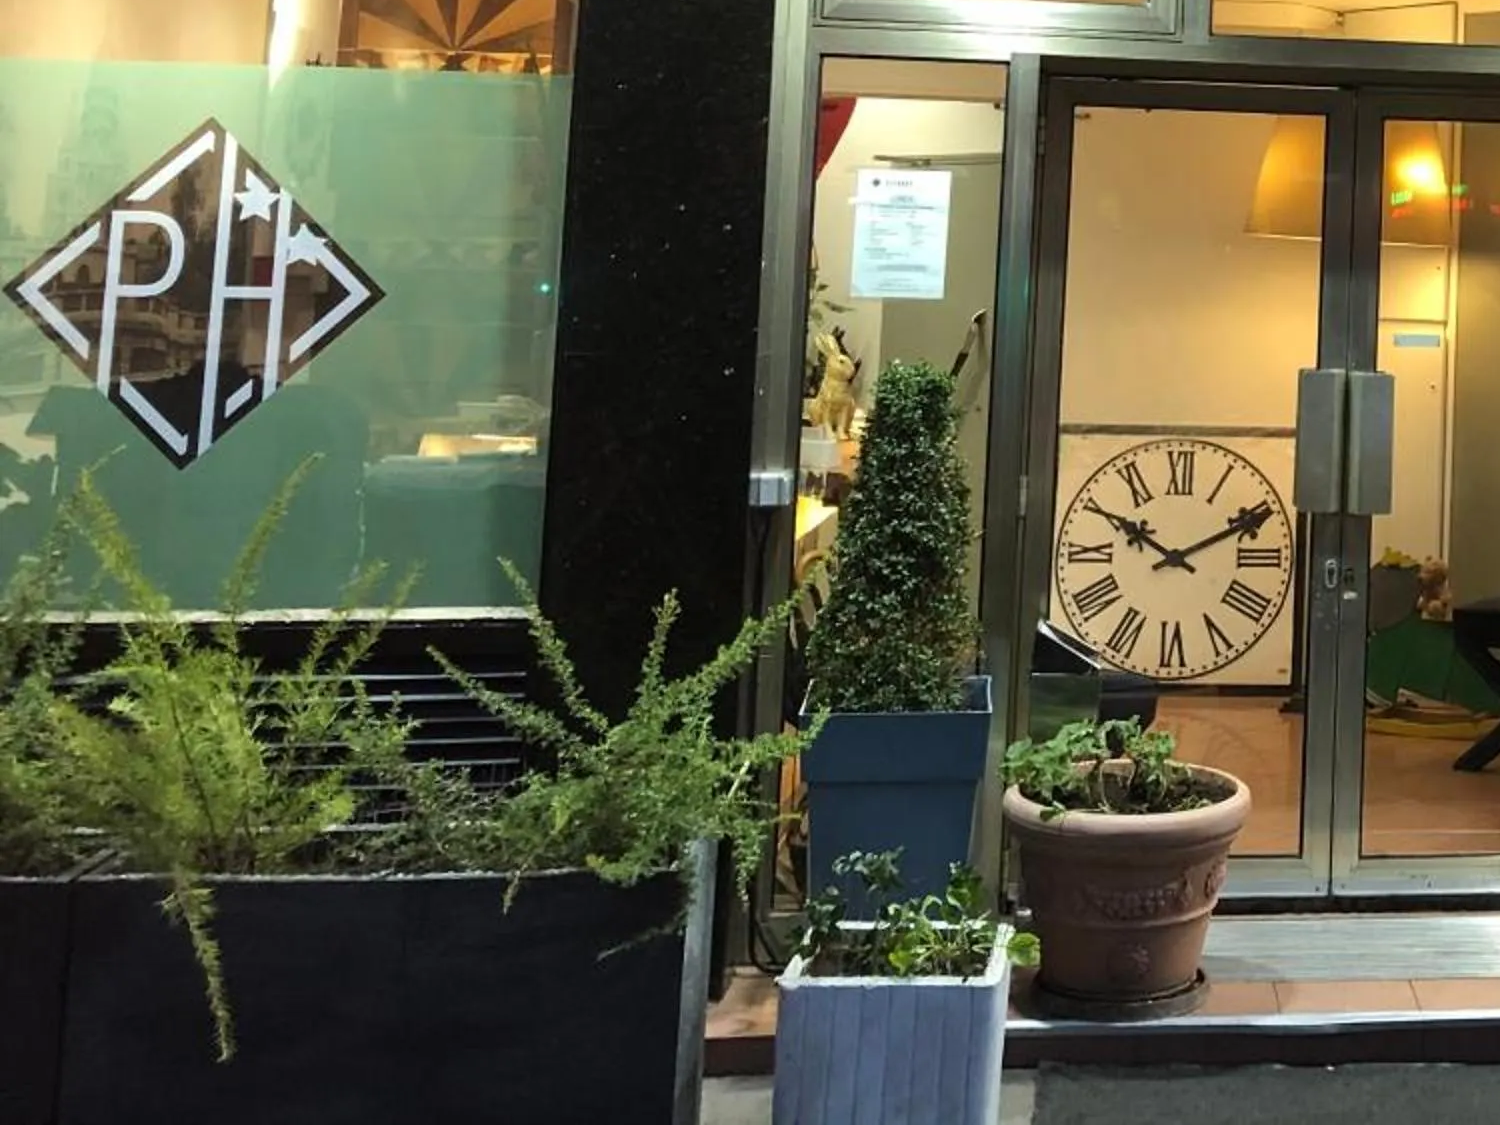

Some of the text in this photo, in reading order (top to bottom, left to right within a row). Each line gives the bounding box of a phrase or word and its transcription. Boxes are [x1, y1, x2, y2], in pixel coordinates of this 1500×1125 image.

[1116, 461, 1155, 509] XI
[1164, 450, 1195, 495] XII
[1206, 463, 1234, 505] I
[1068, 541, 1113, 564] IX
[1236, 547, 1281, 568] III
[1071, 572, 1124, 623] VIII
[1220, 578, 1272, 625] IIII
[1105, 606, 1147, 659] VII
[1159, 620, 1187, 668] VI
[1202, 612, 1235, 657] V
